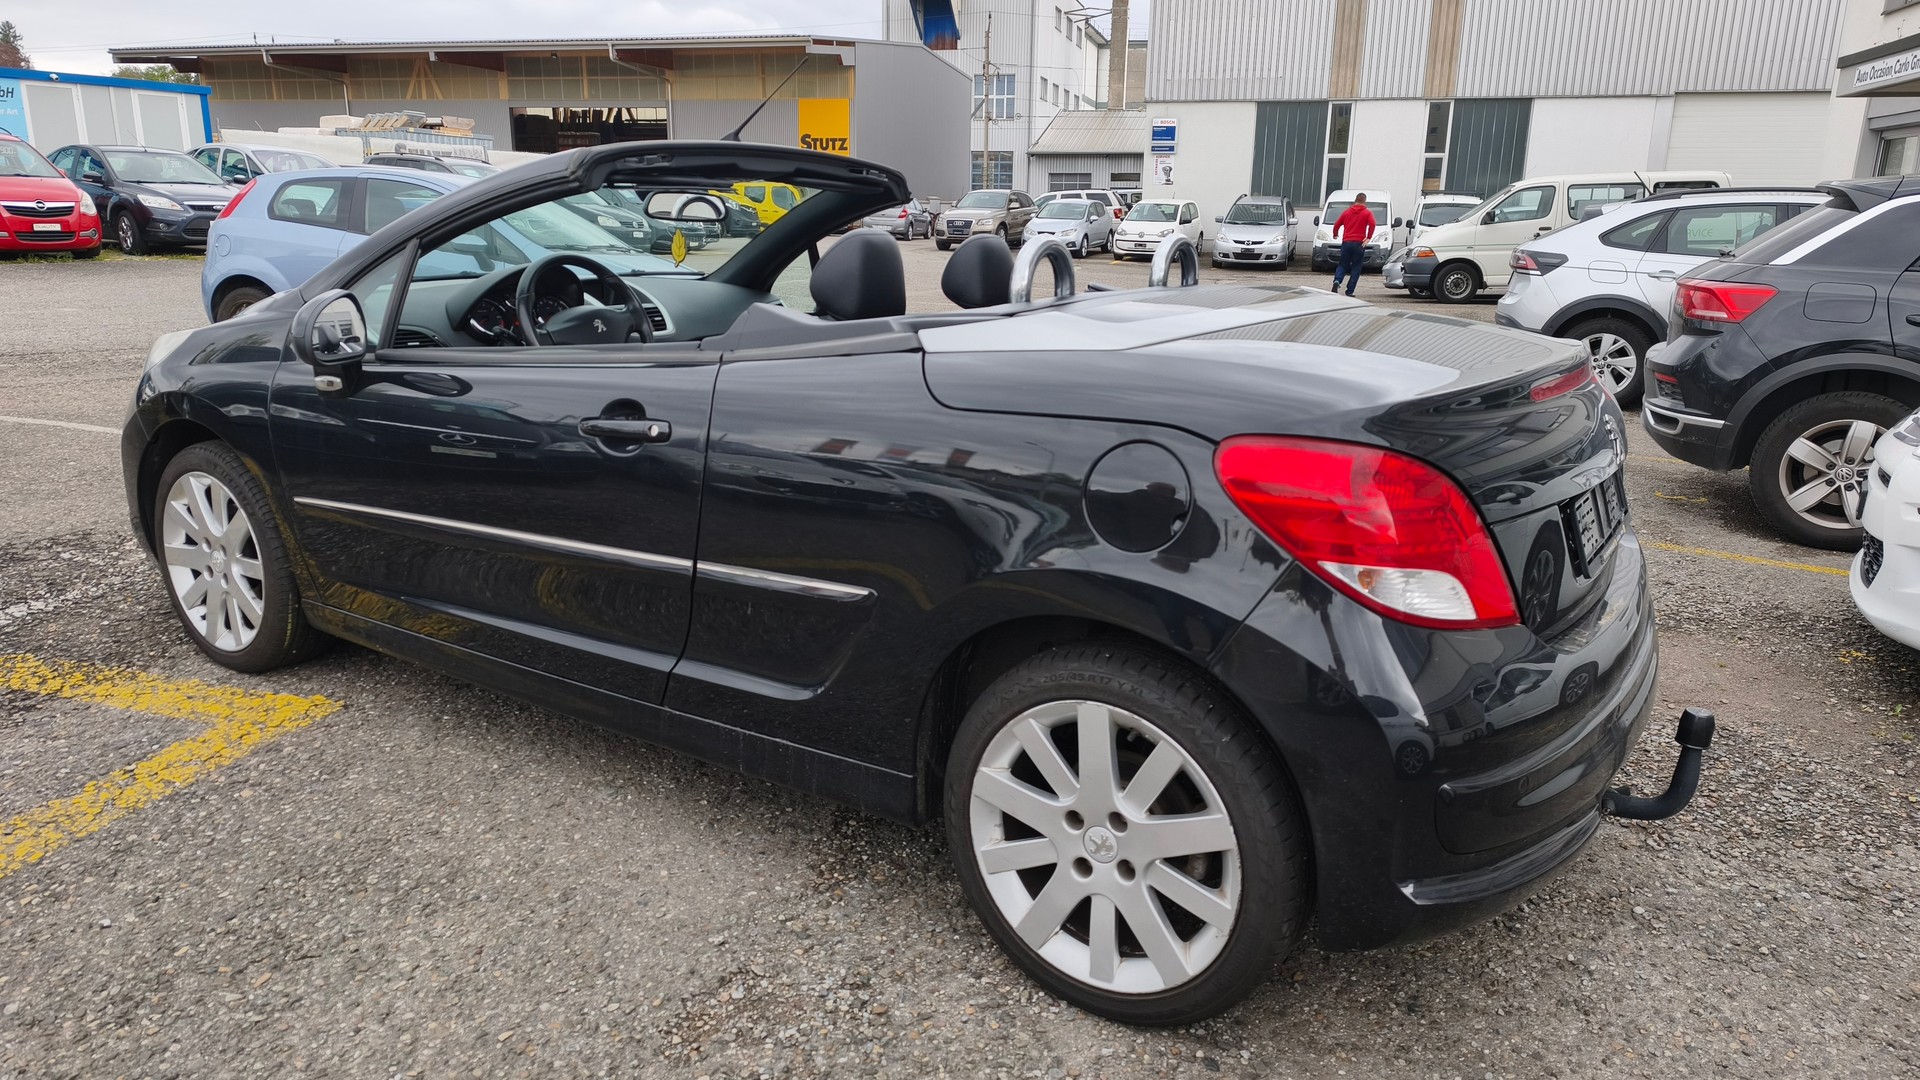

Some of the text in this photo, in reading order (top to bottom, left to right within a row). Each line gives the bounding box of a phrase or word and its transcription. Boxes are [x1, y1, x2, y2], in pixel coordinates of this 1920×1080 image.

[1855, 69, 1869, 84] Auto
[1869, 61, 1893, 80] Occasion
[1893, 57, 1910, 74] Carlo
